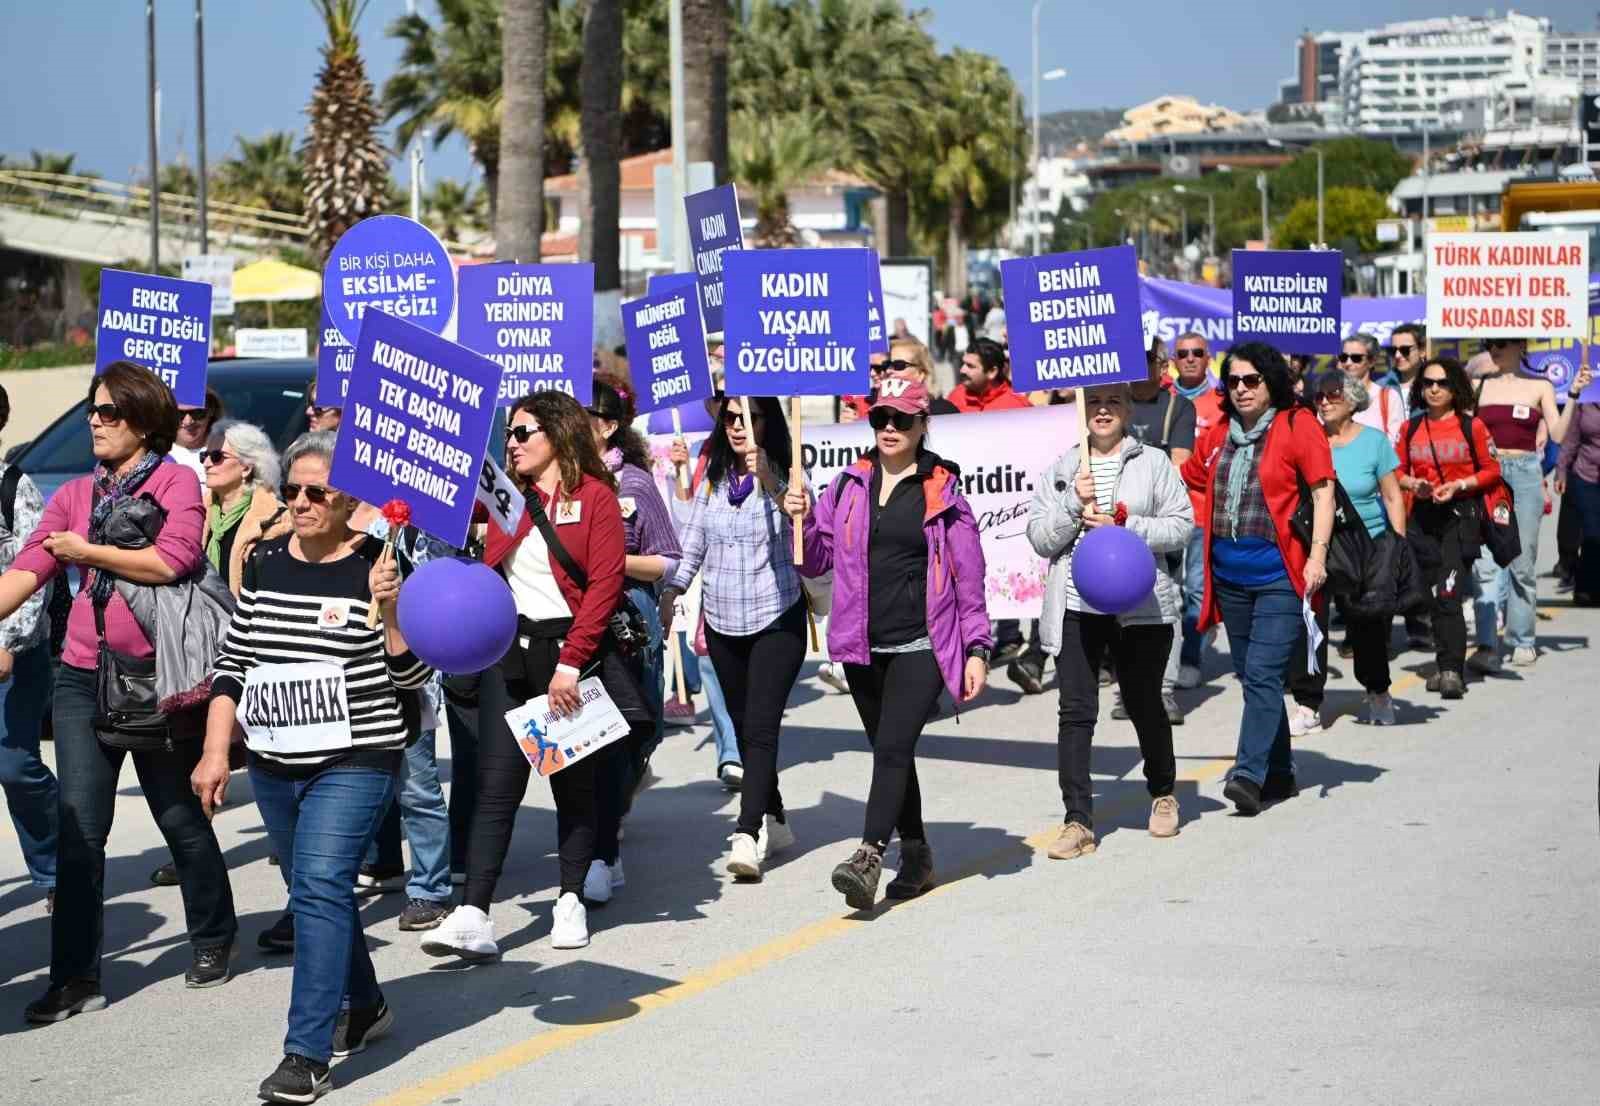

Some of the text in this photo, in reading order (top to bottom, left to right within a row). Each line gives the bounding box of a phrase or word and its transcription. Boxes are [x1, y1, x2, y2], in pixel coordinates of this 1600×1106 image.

[700, 213, 727, 241] KADIN
[340, 250, 436, 271] BİR KİŞİ DAHA
[1435, 245, 1582, 266] TÜRK KADINLAR
[342, 270, 436, 296] EKSİLME-
[497, 272, 553, 296] DÜNYA
[761, 272, 829, 298] KADIN
[1038, 262, 1100, 292] BENİM
[1244, 273, 1328, 294] KATLEDİLEN
[1443, 273, 1571, 297] KONSEYİ DER.
[132, 287, 180, 313] ERKEK
[703, 276, 724, 308] POLİT
[484, 297, 564, 321] YERİNDEN
[635, 295, 686, 329] MÜNFERİT
[1029, 290, 1116, 323] BEDENİM
[1250, 298, 1322, 314] KADINLAR
[1442, 307, 1535, 330] KUŞADASI
[1541, 308, 1572, 331] ŞB.
[102, 309, 207, 343] ADALET DEĞİL
[758, 310, 831, 341] YAŞAM
[1044, 320, 1107, 351] BENİM
[1237, 311, 1336, 334] İSYANIMIZDIR
[497, 328, 552, 348] OYNAR
[649, 323, 680, 350] DEĞİL
[124, 338, 183, 367] GERÇEK
[336, 349, 355, 372] ÖLÜ
[484, 354, 564, 373] ADINLAR
[651, 350, 685, 375] ERKEK
[737, 342, 856, 372] ÖZGÜRLÜK
[371, 340, 449, 398] KURTULUŞ
[451, 375, 484, 409] YOK
[1036, 351, 1121, 381] KARARIM
[499, 375, 530, 399] GÜR
[651, 369, 692, 405] ŞİDDETİ
[881, 379, 911, 397] W
[379, 379, 408, 411] TEK
[408, 392, 461, 437] BAŞINA
[354, 403, 473, 478] YA HEP BERABER
[354, 439, 460, 507] YA HİÇBİRİMİZ
[957, 466, 1033, 496] ridir.
